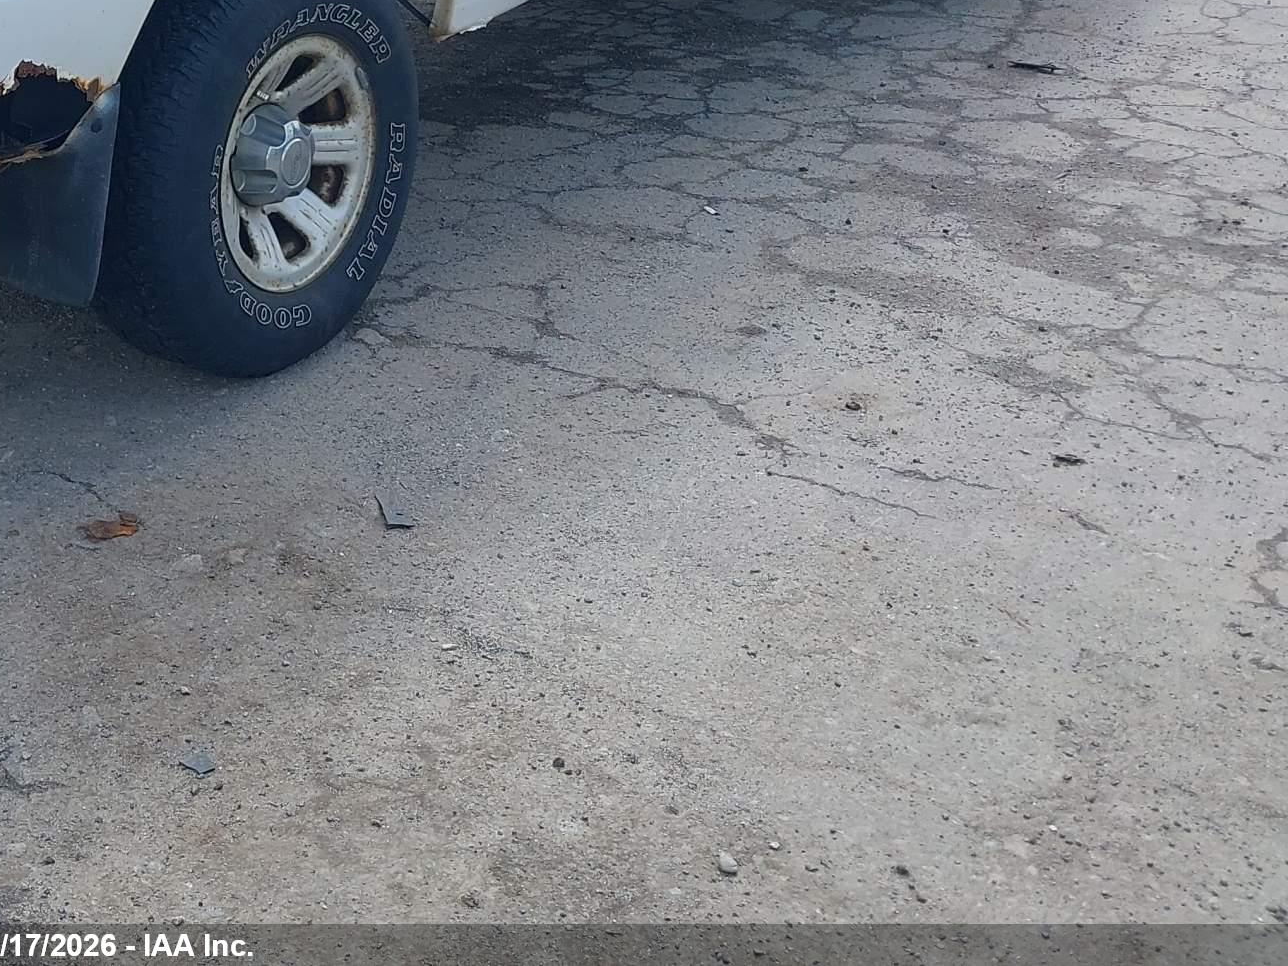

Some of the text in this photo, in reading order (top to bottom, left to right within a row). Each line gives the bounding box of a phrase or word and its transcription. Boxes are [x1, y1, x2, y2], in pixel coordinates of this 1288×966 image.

[245, 2, 392, 79] WRANGLER
[209, 144, 312, 328] GOODYEAR
[346, 122, 406, 281] RADIAL
